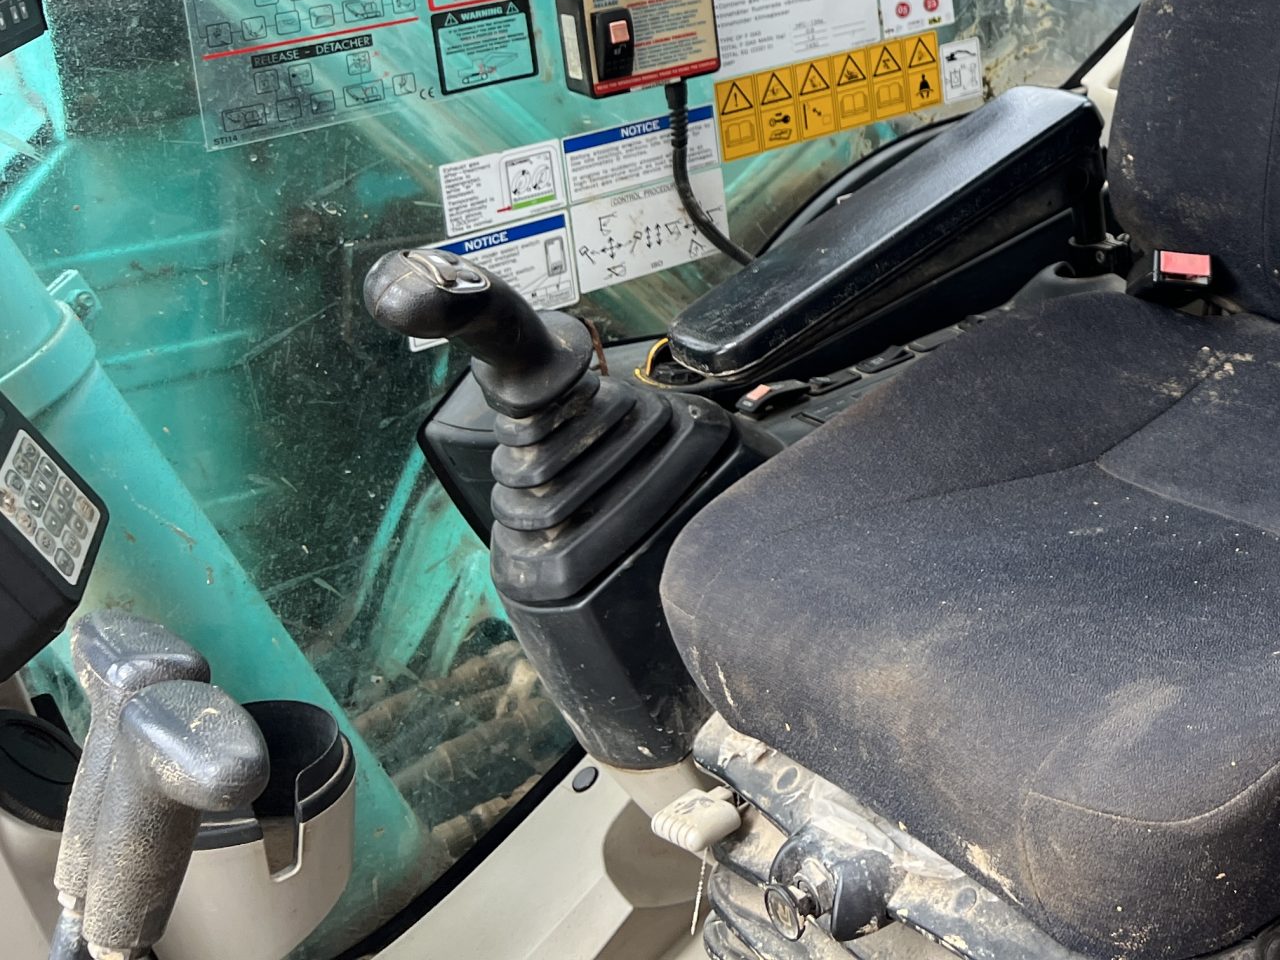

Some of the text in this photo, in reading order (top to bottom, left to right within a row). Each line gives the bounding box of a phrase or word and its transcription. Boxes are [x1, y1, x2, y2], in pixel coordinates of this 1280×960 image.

[461, 7, 503, 20] WARNING
[254, 49, 300, 67] RELEASE
[316, 37, 370, 55] DETACHER
[620, 120, 660, 138] NOTICE
[464, 232, 509, 252] NOTICE
